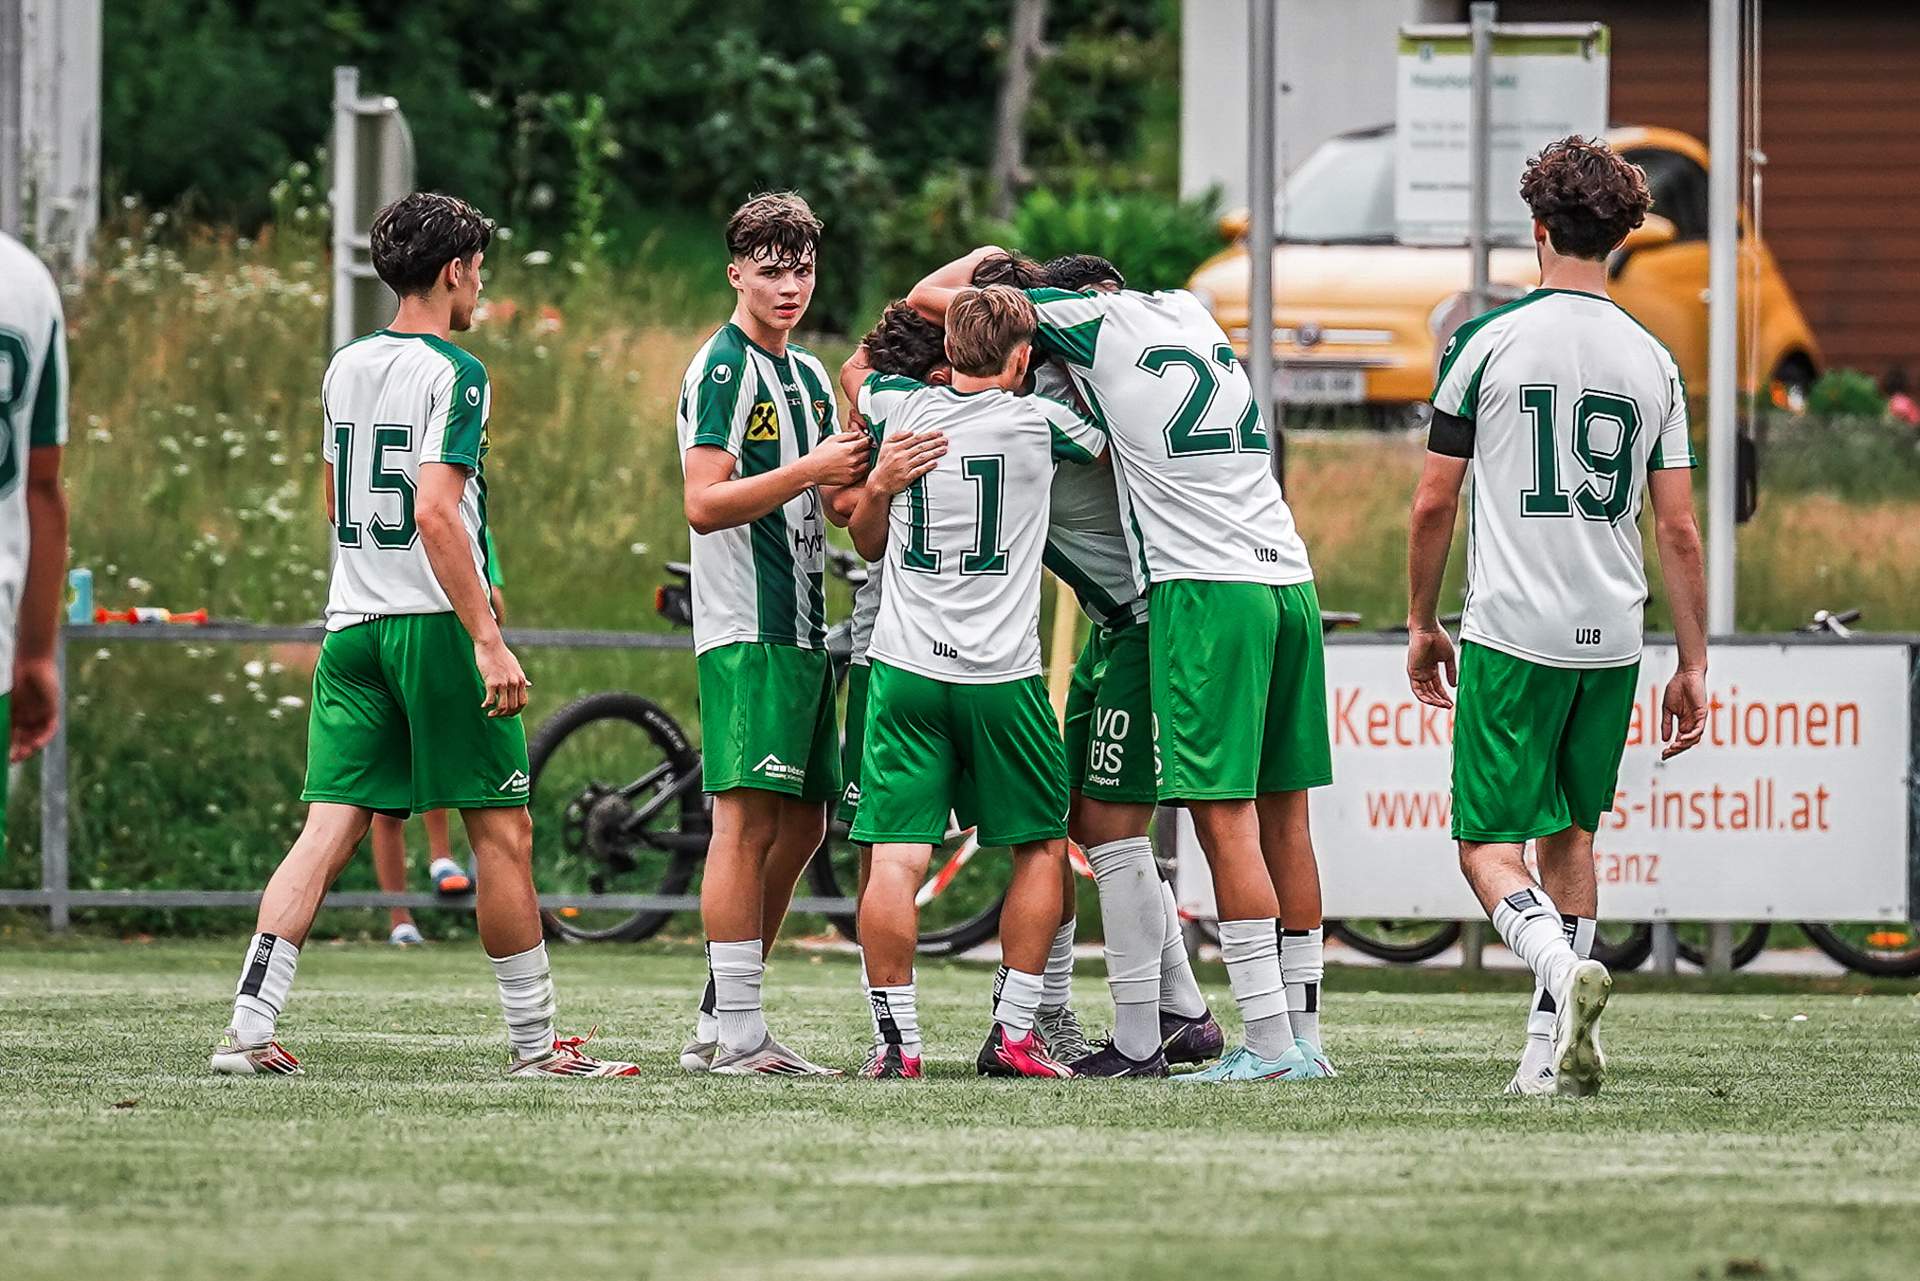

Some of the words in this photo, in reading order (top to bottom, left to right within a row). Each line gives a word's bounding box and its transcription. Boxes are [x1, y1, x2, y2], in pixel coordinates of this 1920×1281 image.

[1135, 342, 1273, 459] 22
[1520, 384, 1642, 528] 19
[334, 422, 420, 550] 15
[900, 454, 1009, 576] 11
[1254, 548, 1278, 562] U18
[1576, 629, 1601, 644] U18
[1096, 706, 1130, 740] VO
